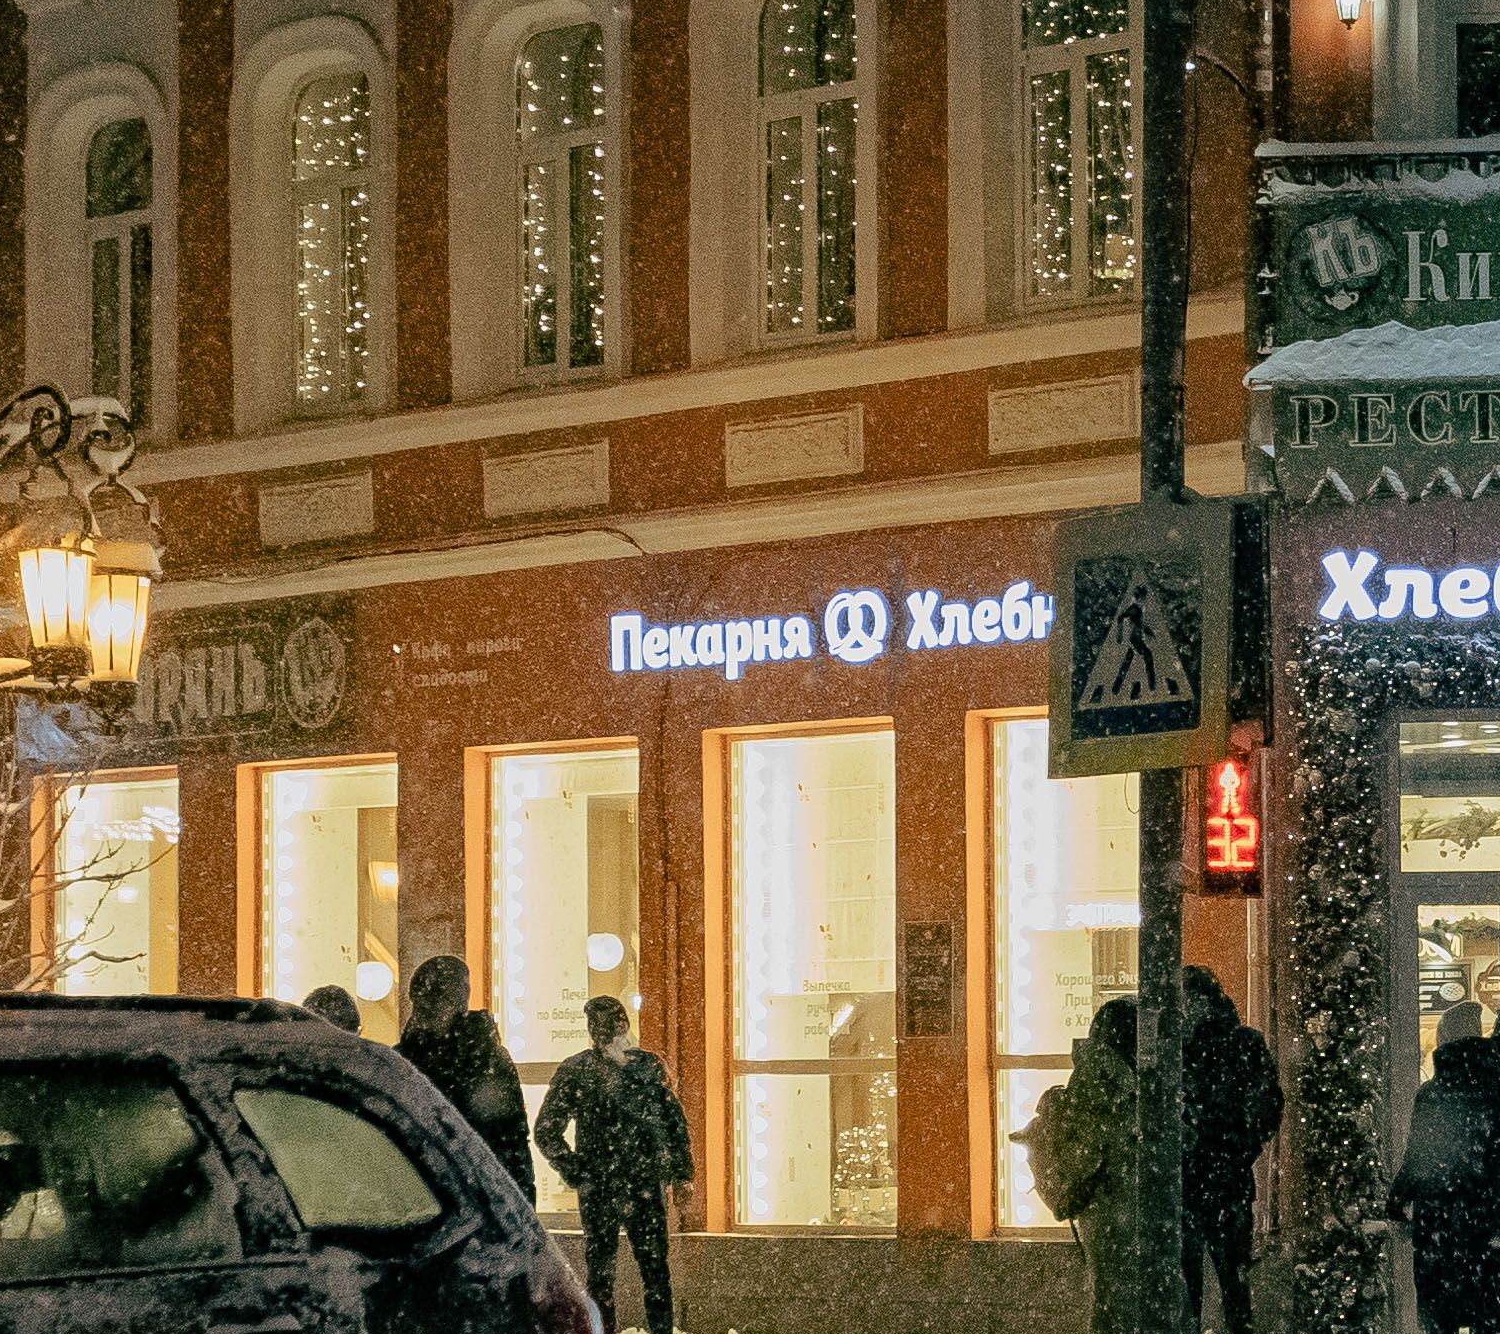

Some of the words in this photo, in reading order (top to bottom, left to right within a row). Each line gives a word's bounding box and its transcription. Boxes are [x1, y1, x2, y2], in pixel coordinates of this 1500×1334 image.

[609, 612, 812, 679] Пекарня
[905, 581, 1056, 651] Хлебн
[1206, 814, 1260, 871] 32
[562, 987, 586, 1000] Печё
